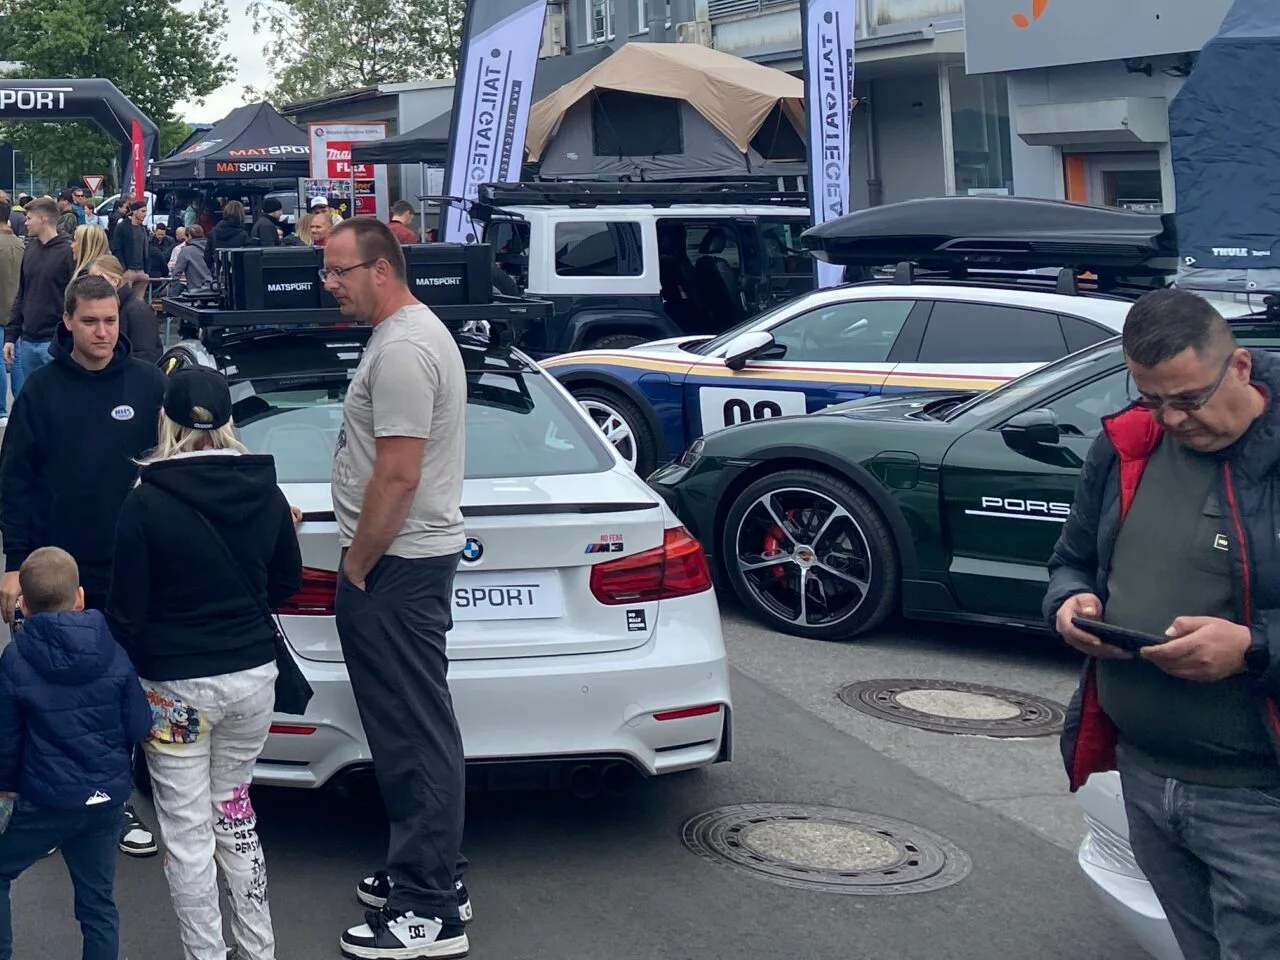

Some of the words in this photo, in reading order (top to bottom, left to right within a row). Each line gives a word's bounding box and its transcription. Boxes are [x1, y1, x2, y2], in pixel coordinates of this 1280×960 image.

[229, 145, 309, 156] MATSPO
[216, 162, 277, 172] MATSPORT
[1212, 248, 1248, 257] THULE
[415, 276, 462, 286] MATSPORT
[267, 282, 313, 292] MATSPORT
[982, 496, 1071, 515] PORS
[598, 543, 624, 553] M3
[454, 584, 540, 608] SPORT
